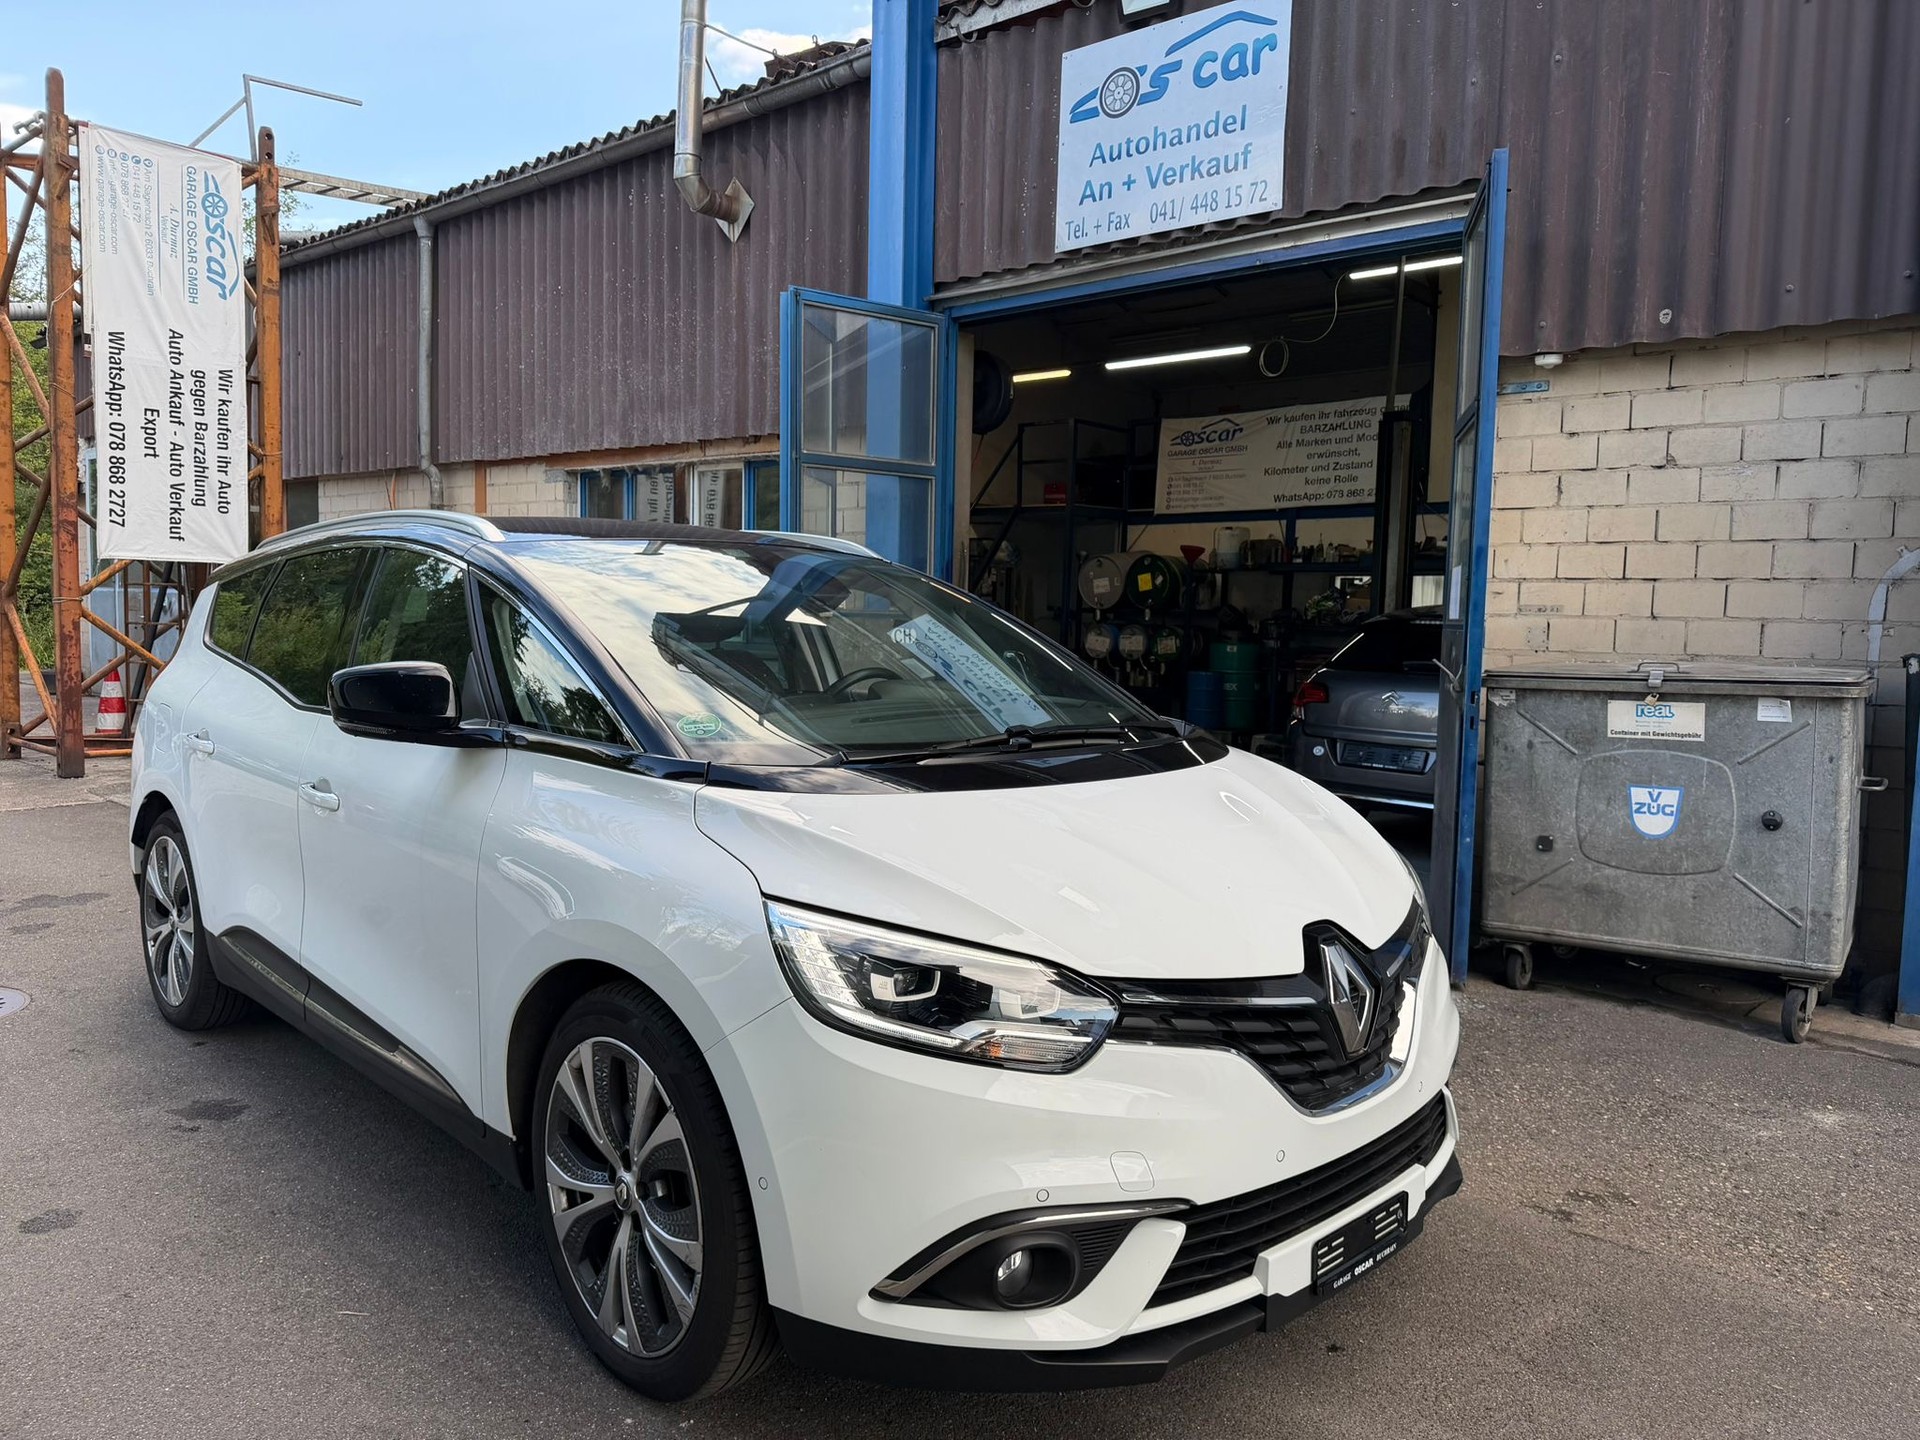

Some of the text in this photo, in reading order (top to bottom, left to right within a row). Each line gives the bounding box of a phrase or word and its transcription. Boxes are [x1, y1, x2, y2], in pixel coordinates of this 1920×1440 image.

[1193, 33, 1278, 89] car
[1089, 104, 1247, 168] Autohandel
[1079, 142, 1253, 206] An + Verkauf
[133, 200, 141, 210] 15
[133, 212, 141, 223] 72
[1065, 217, 1088, 241] Tel.
[1107, 211, 1131, 232] Fax
[1150, 196, 1185, 228] 041/
[1190, 190, 1219, 215] 448
[1225, 185, 1243, 209] 15
[1250, 179, 1268, 204] 72
[186, 165, 199, 304] GARAGE OSCAR GMBH
[168, 328, 184, 365] Auto
[169, 369, 185, 426] Ankauf
[1266, 415, 1282, 425] Wir
[1284, 412, 1316, 423] kaufen
[1318, 410, 1331, 420] ihr
[1333, 406, 1377, 419] fahrzeug
[1300, 419, 1372, 434] BARZAHLUNG
[105, 331, 126, 528] WhatsApp: 078 868 2727
[140, 407, 160, 459] Export
[190, 369, 210, 507] gegen Barzahlung
[217, 369, 233, 515] Wir kaufen ihr Auto
[1276, 440, 1293, 449] Alle
[1296, 436, 1332, 448] Marken
[1335, 434, 1353, 444] und
[169, 441, 184, 477] Auto
[1198, 447, 1224, 455] OSCAR
[1264, 459, 1373, 477] Kilometer und Zustand
[1305, 474, 1359, 486] keine Rolle
[1273, 492, 1325, 503] WhatsApp:
[169, 482, 185, 542] Verkauf
[1652, 731, 1702, 739] Gewichtsgebühr
[1634, 802, 1675, 817] ZUG
[1647, 790, 1662, 802] V
[1354, 1257, 1374, 1276] OSCAR
